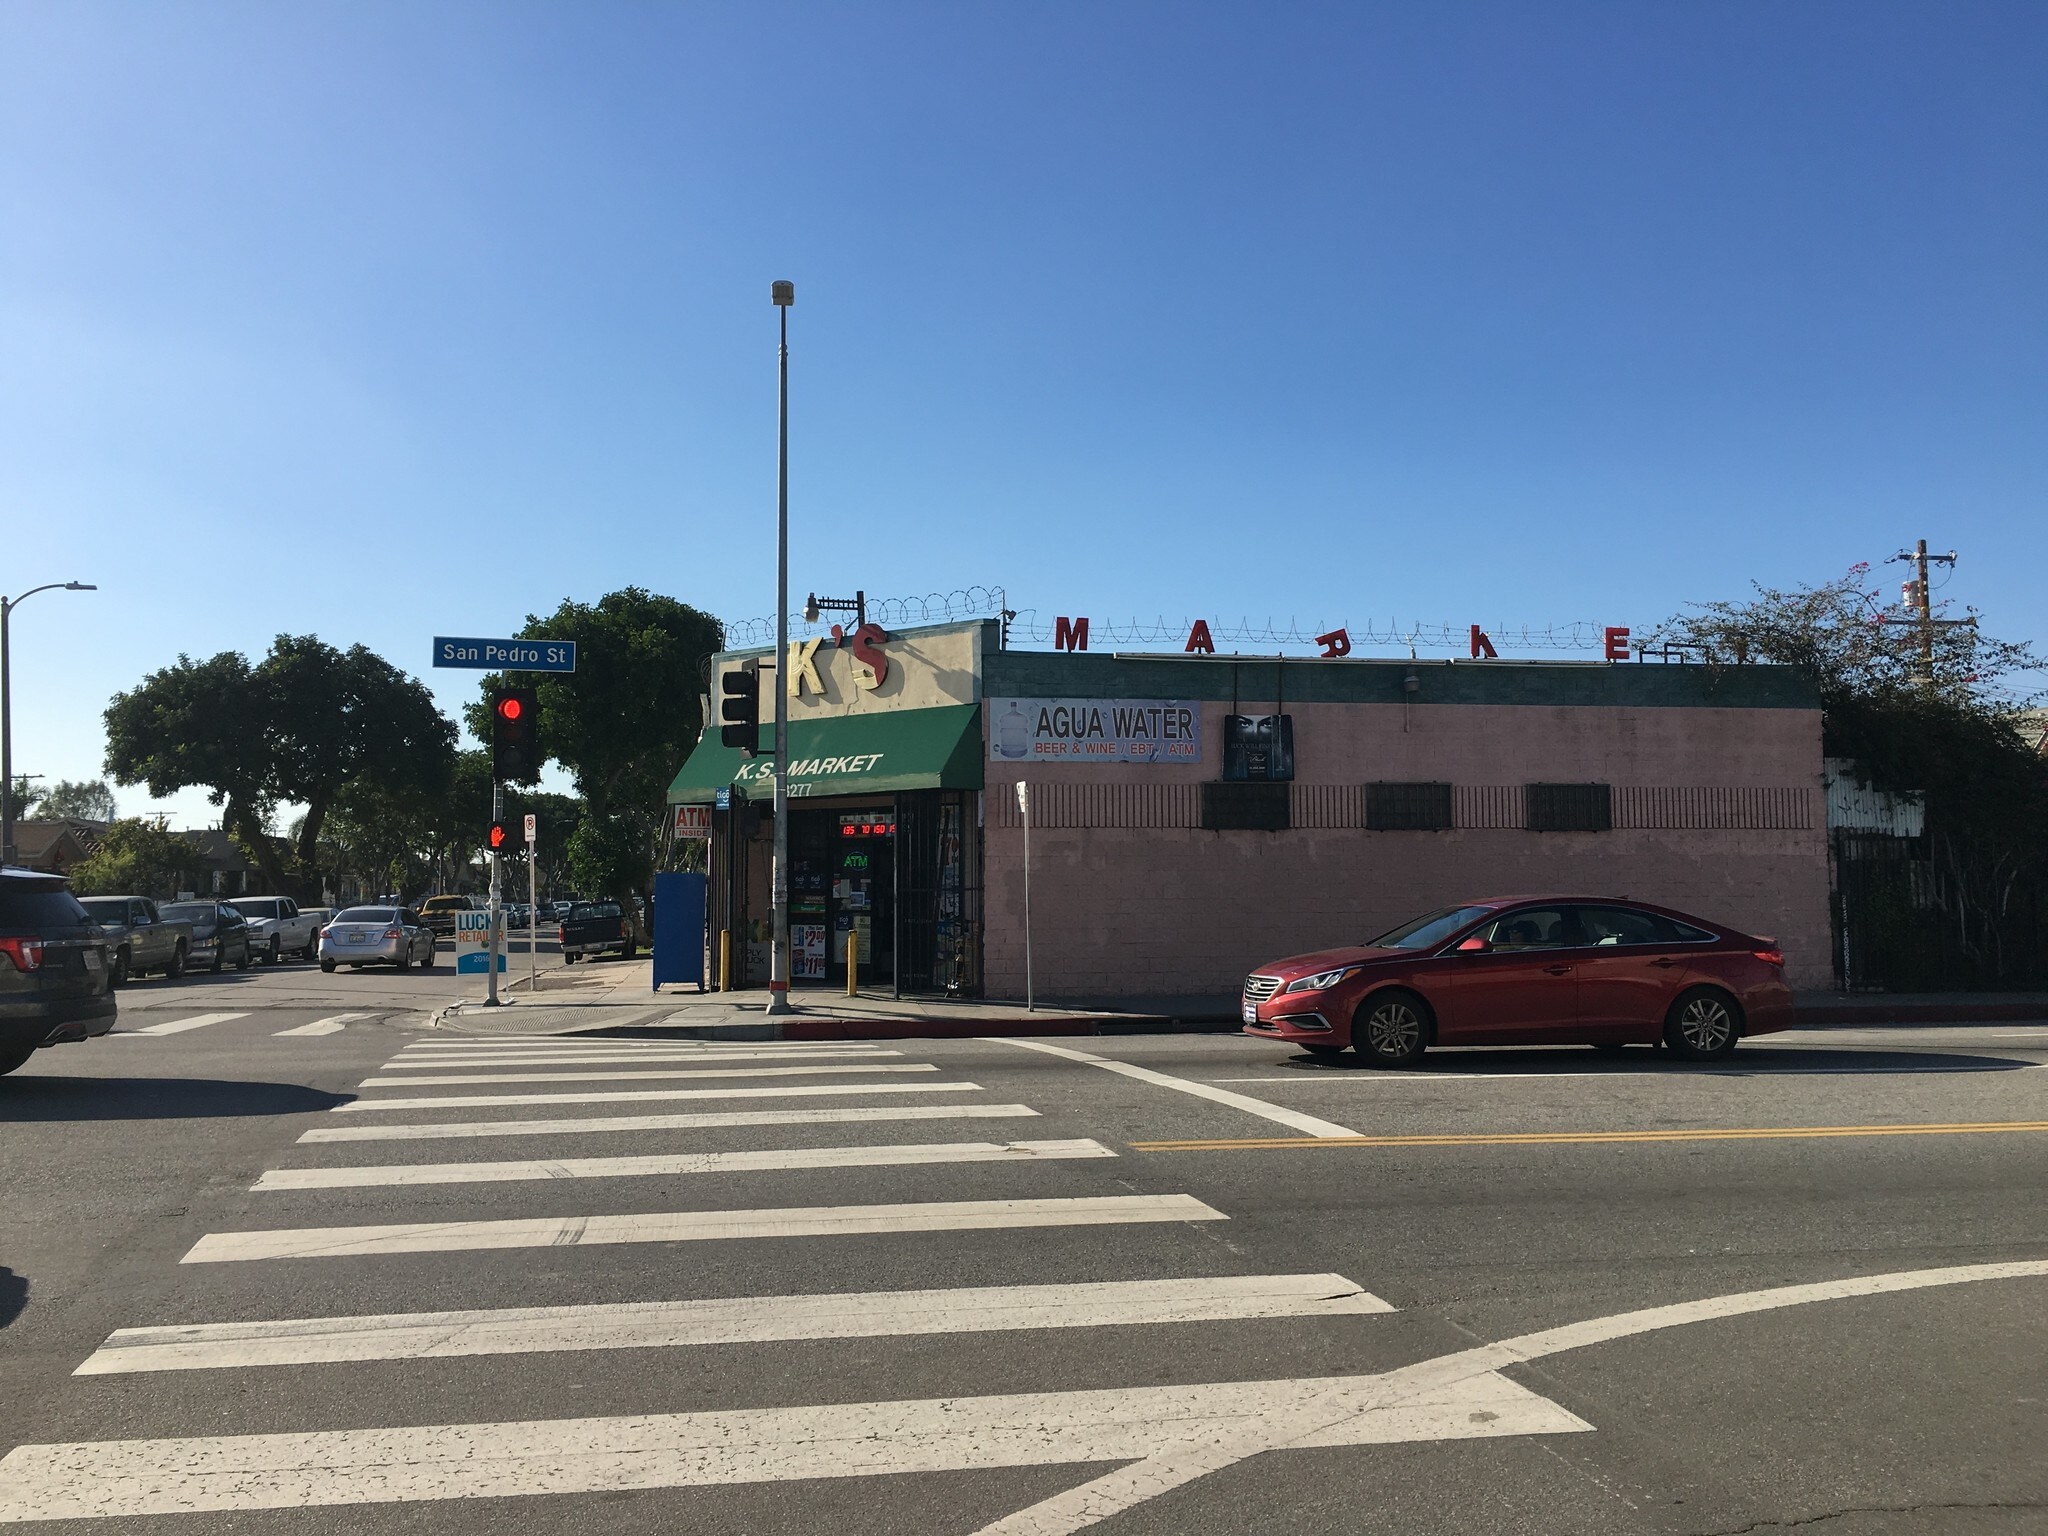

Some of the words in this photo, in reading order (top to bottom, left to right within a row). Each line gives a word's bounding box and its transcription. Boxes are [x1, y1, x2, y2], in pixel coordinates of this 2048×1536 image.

[443, 644, 478, 660] San
[485, 645, 539, 663] Pedro
[546, 647, 566, 663] St
[1035, 706, 1105, 738] AGUA
[1112, 706, 1194, 739] WATER
[1035, 742, 1067, 754] BEER
[1072, 743, 1081, 754] &
[1085, 743, 1116, 754] WINE
[1130, 743, 1153, 755] EBT
[1168, 743, 1194, 755] ATM
[786, 753, 885, 777] MARKET
[676, 807, 711, 827] ATM
[679, 829, 708, 837] INSIDE
[844, 855, 868, 867] ATM
[458, 930, 504, 942] RETAILR
